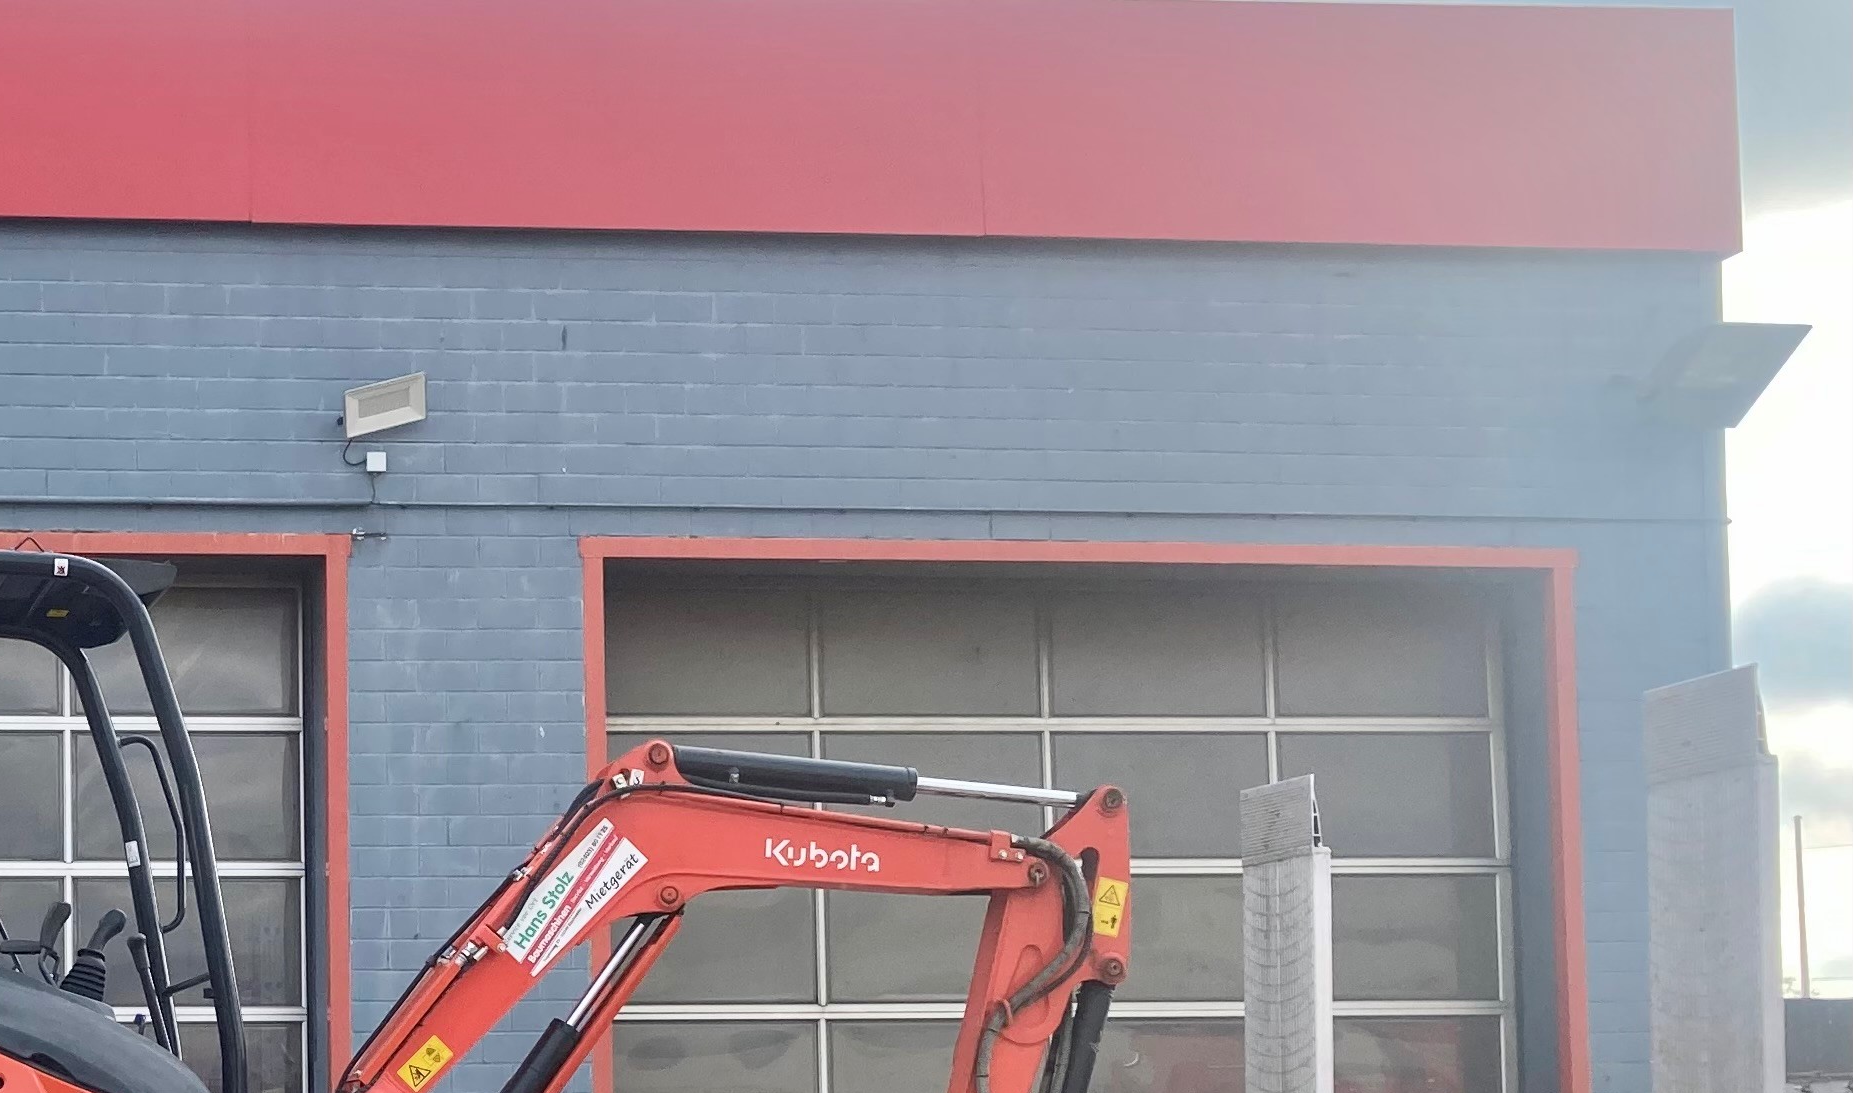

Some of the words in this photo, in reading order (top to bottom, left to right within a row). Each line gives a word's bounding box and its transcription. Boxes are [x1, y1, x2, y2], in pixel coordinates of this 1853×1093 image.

[584, 853, 641, 910] Mietgerät
[765, 838, 880, 872] Kubota
[514, 910, 548, 950] Hans
[542, 870, 575, 910] Stolz
[527, 904, 572, 964] Baumaschinen
